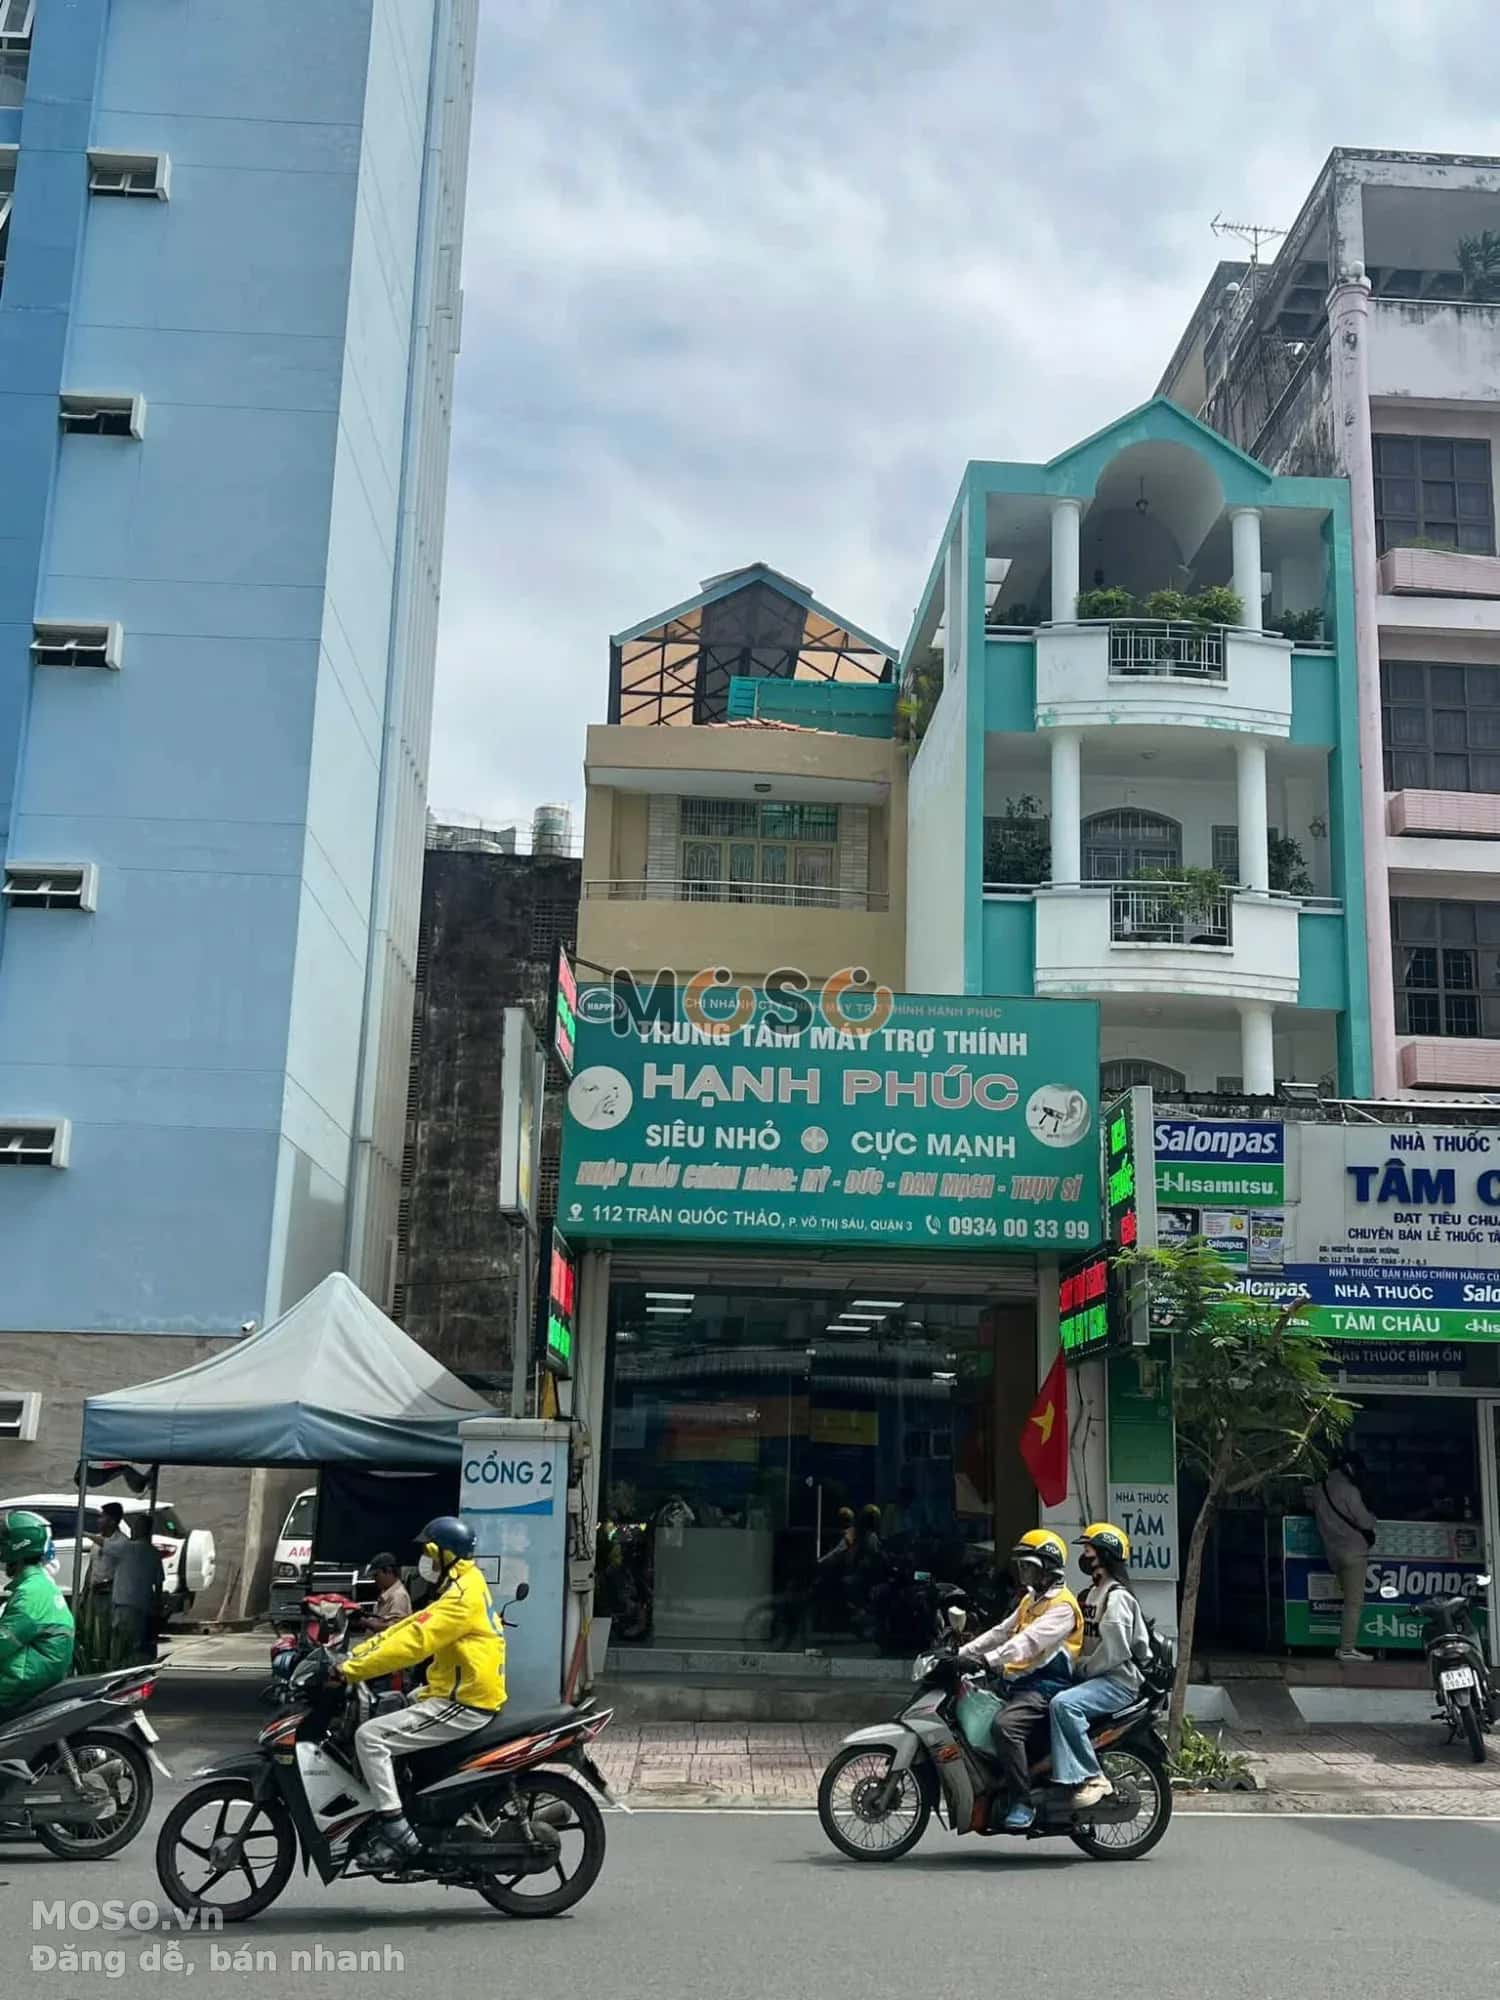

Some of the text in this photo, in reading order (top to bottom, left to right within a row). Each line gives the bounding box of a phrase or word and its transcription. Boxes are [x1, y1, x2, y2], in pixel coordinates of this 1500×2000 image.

[639, 1020, 730, 1047] TRUNG
[810, 1022, 874, 1051] MÁY
[882, 1027, 936, 1058] TRỢ
[943, 1027, 1028, 1057] THÍNH
[643, 1062, 1019, 1111] HẠNH PHÚC
[645, 1119, 1016, 1163] SIÊU NHỎ CỰC MẠNH
[1154, 1124, 1277, 1158] Salonpas
[1390, 1131, 1426, 1151] NHÀ
[1433, 1130, 1490, 1153] THUỐC
[939, 1173, 996, 1202] MẠCH
[1155, 1171, 1274, 1195] Hisamitsu
[1346, 1157, 1456, 1205] TÂM
[591, 1205, 624, 1222] 112
[733, 1207, 786, 1229] THẢO,
[821, 1218, 838, 1231] THỊ
[905, 1221, 913, 1232] 3
[948, 1215, 1090, 1240] 0934 00 33 99
[1428, 1211, 1462, 1225] TIÊU
[1347, 1227, 1393, 1241] CHUYÊN
[1399, 1227, 1422, 1241] BÁN
[1427, 1226, 1441, 1241] LẺ
[1445, 1228, 1484, 1243] THUỐC
[1328, 1266, 1348, 1277] NHÀ
[1334, 1282, 1434, 1300] NHÀ THUỐC
[1331, 1311, 1376, 1331] TÂM
[1382, 1313, 1441, 1333] CHÂU
[464, 1450, 553, 1485] CỔNG 2
[1122, 1508, 1164, 1537] TÂM
[1129, 1541, 1171, 1570] HÂU
